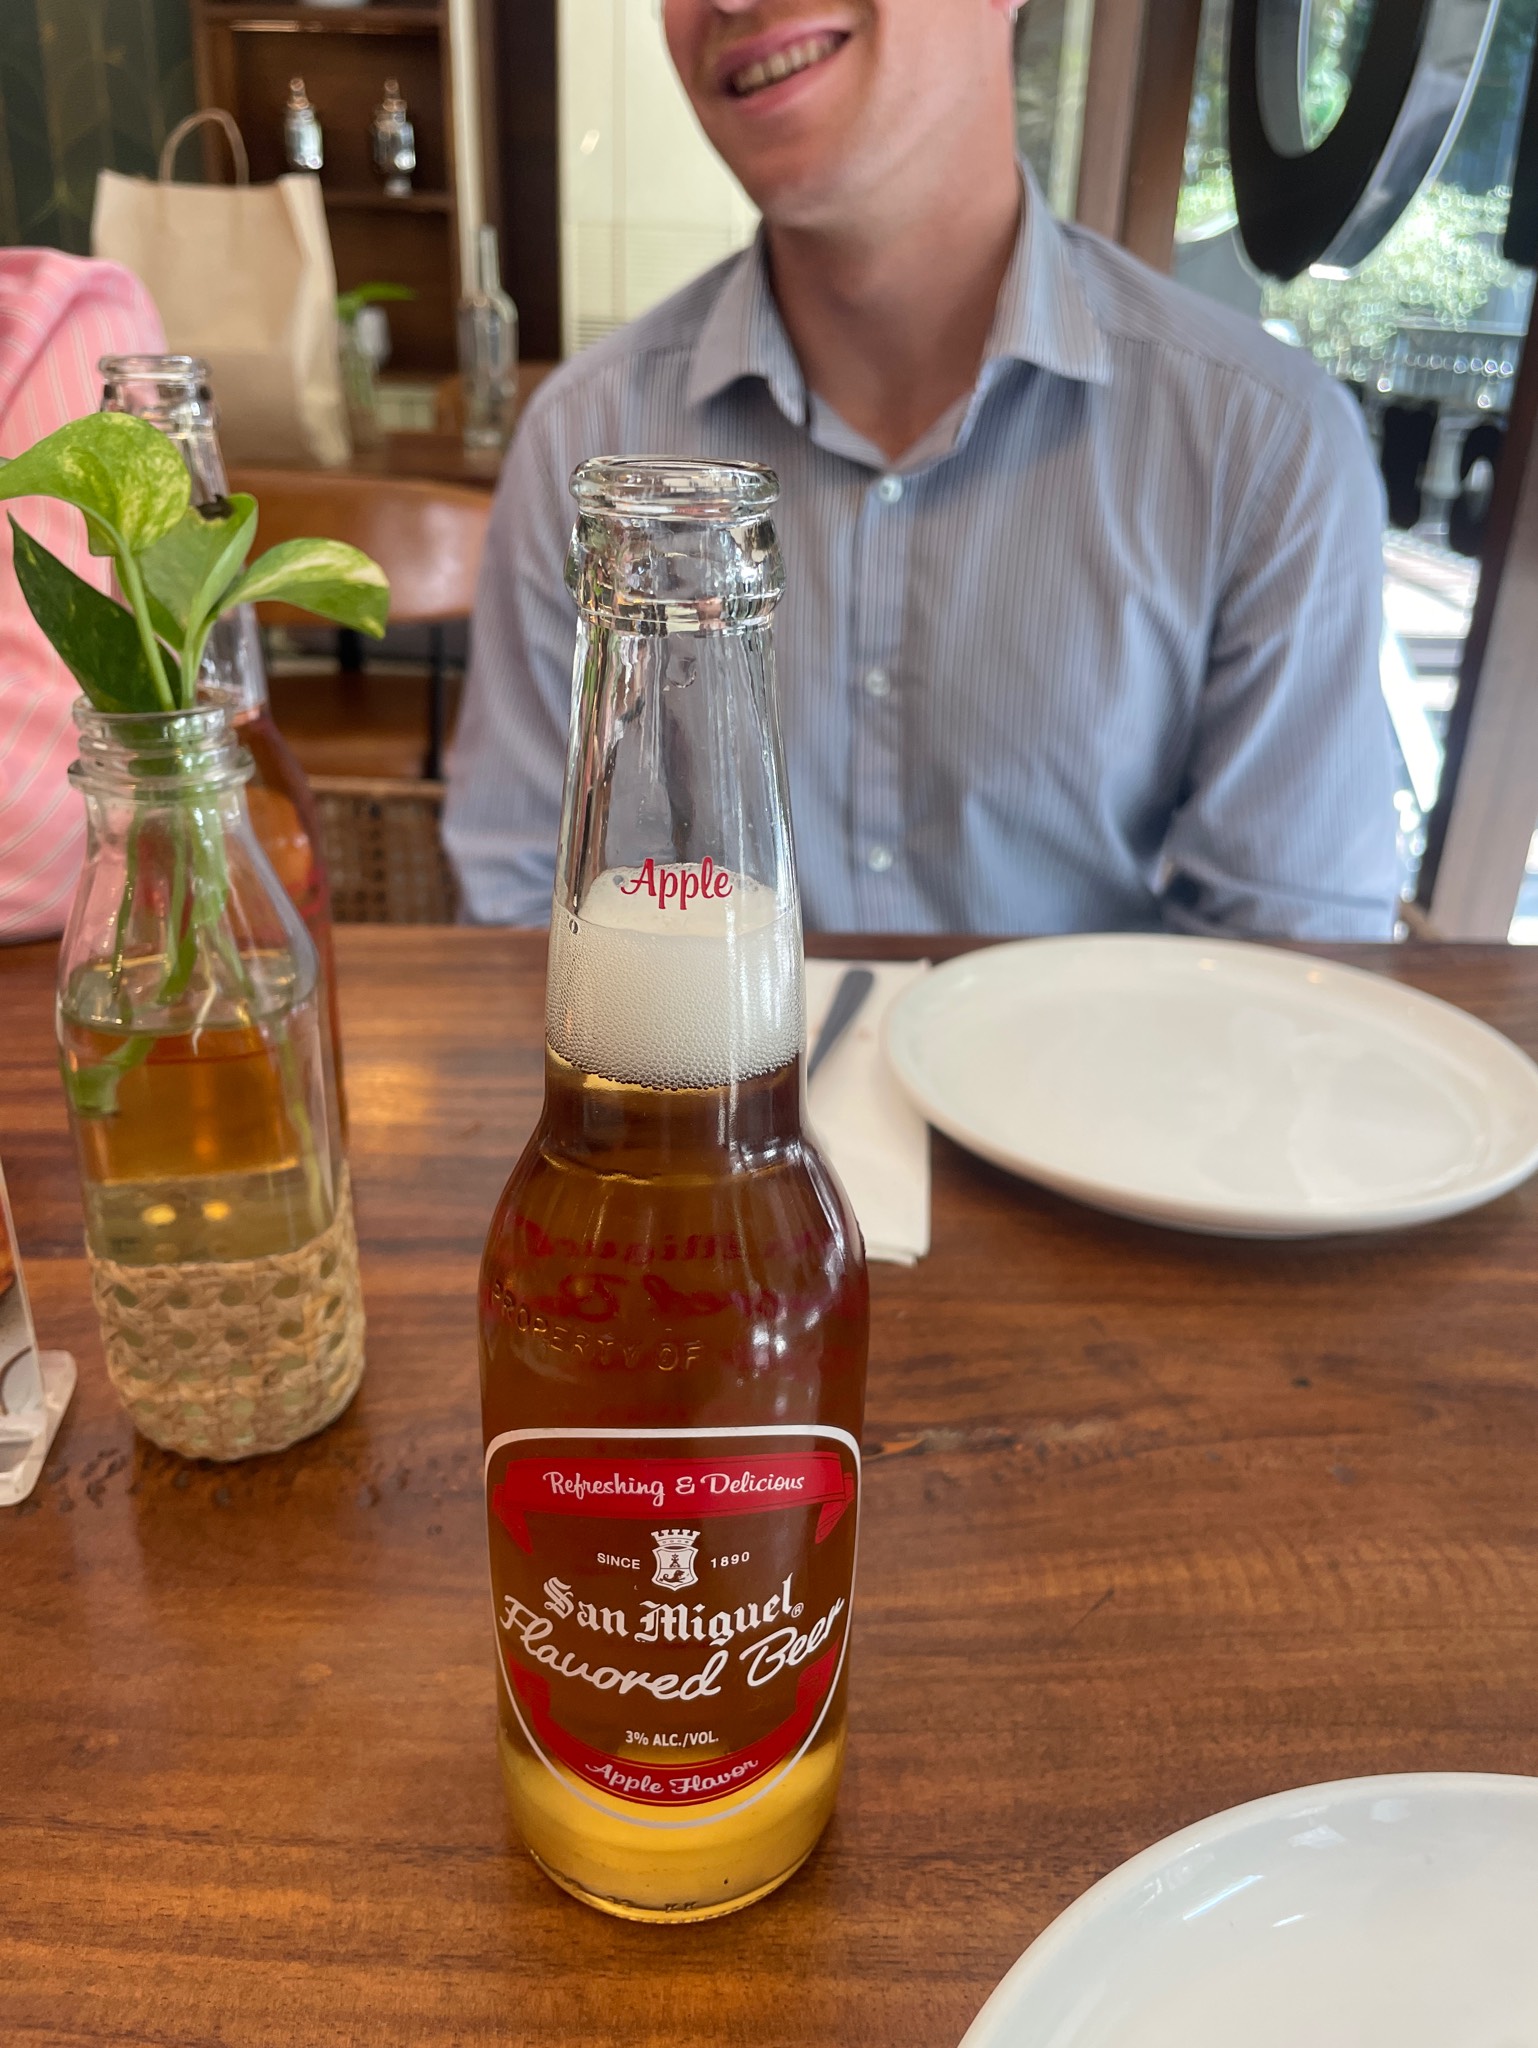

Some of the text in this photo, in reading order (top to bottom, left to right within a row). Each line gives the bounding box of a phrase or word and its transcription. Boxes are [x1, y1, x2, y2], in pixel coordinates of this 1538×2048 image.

[621, 856, 733, 911] Apple
[655, 1340, 704, 1372] OF
[542, 1471, 806, 1507] Refreshing & Delicious
[596, 1551, 751, 1570] SINCE 1890
[542, 1576, 629, 1637] San
[499, 1594, 845, 1701] Flavored Beer
[625, 1730, 720, 1748] 3% ALC./VOL.
[585, 1759, 759, 1795] Apple Flavor
